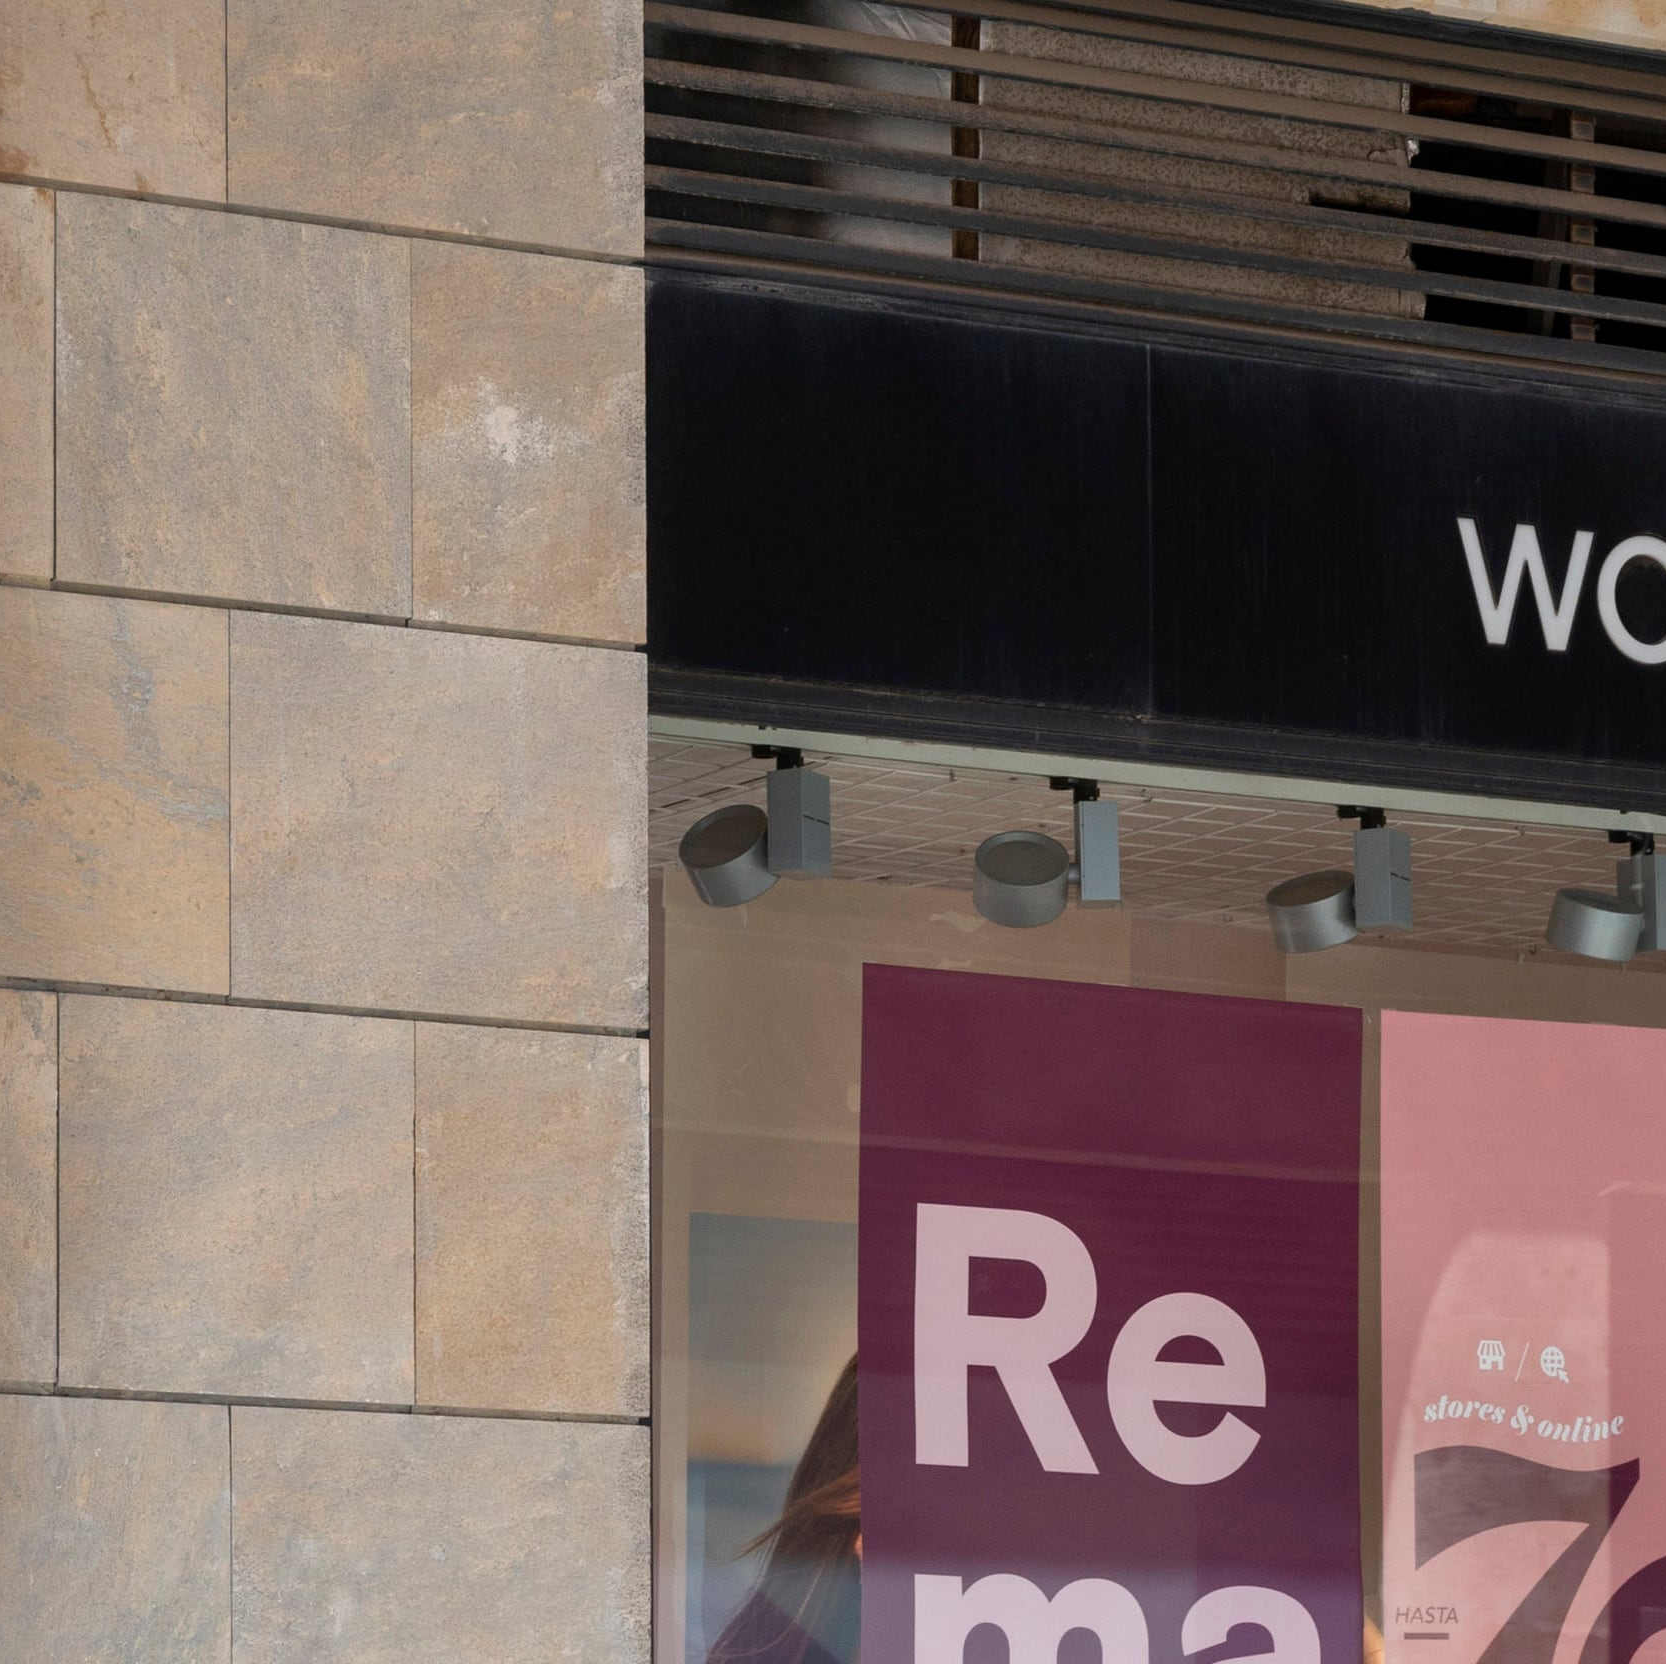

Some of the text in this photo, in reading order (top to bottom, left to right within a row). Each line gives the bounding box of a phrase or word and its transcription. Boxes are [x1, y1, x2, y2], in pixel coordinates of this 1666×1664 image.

[914, 1202, 1267, 1486] Re
[1423, 1394, 1625, 1443] stores & online
[1395, 1606, 1459, 1624] HASTA
